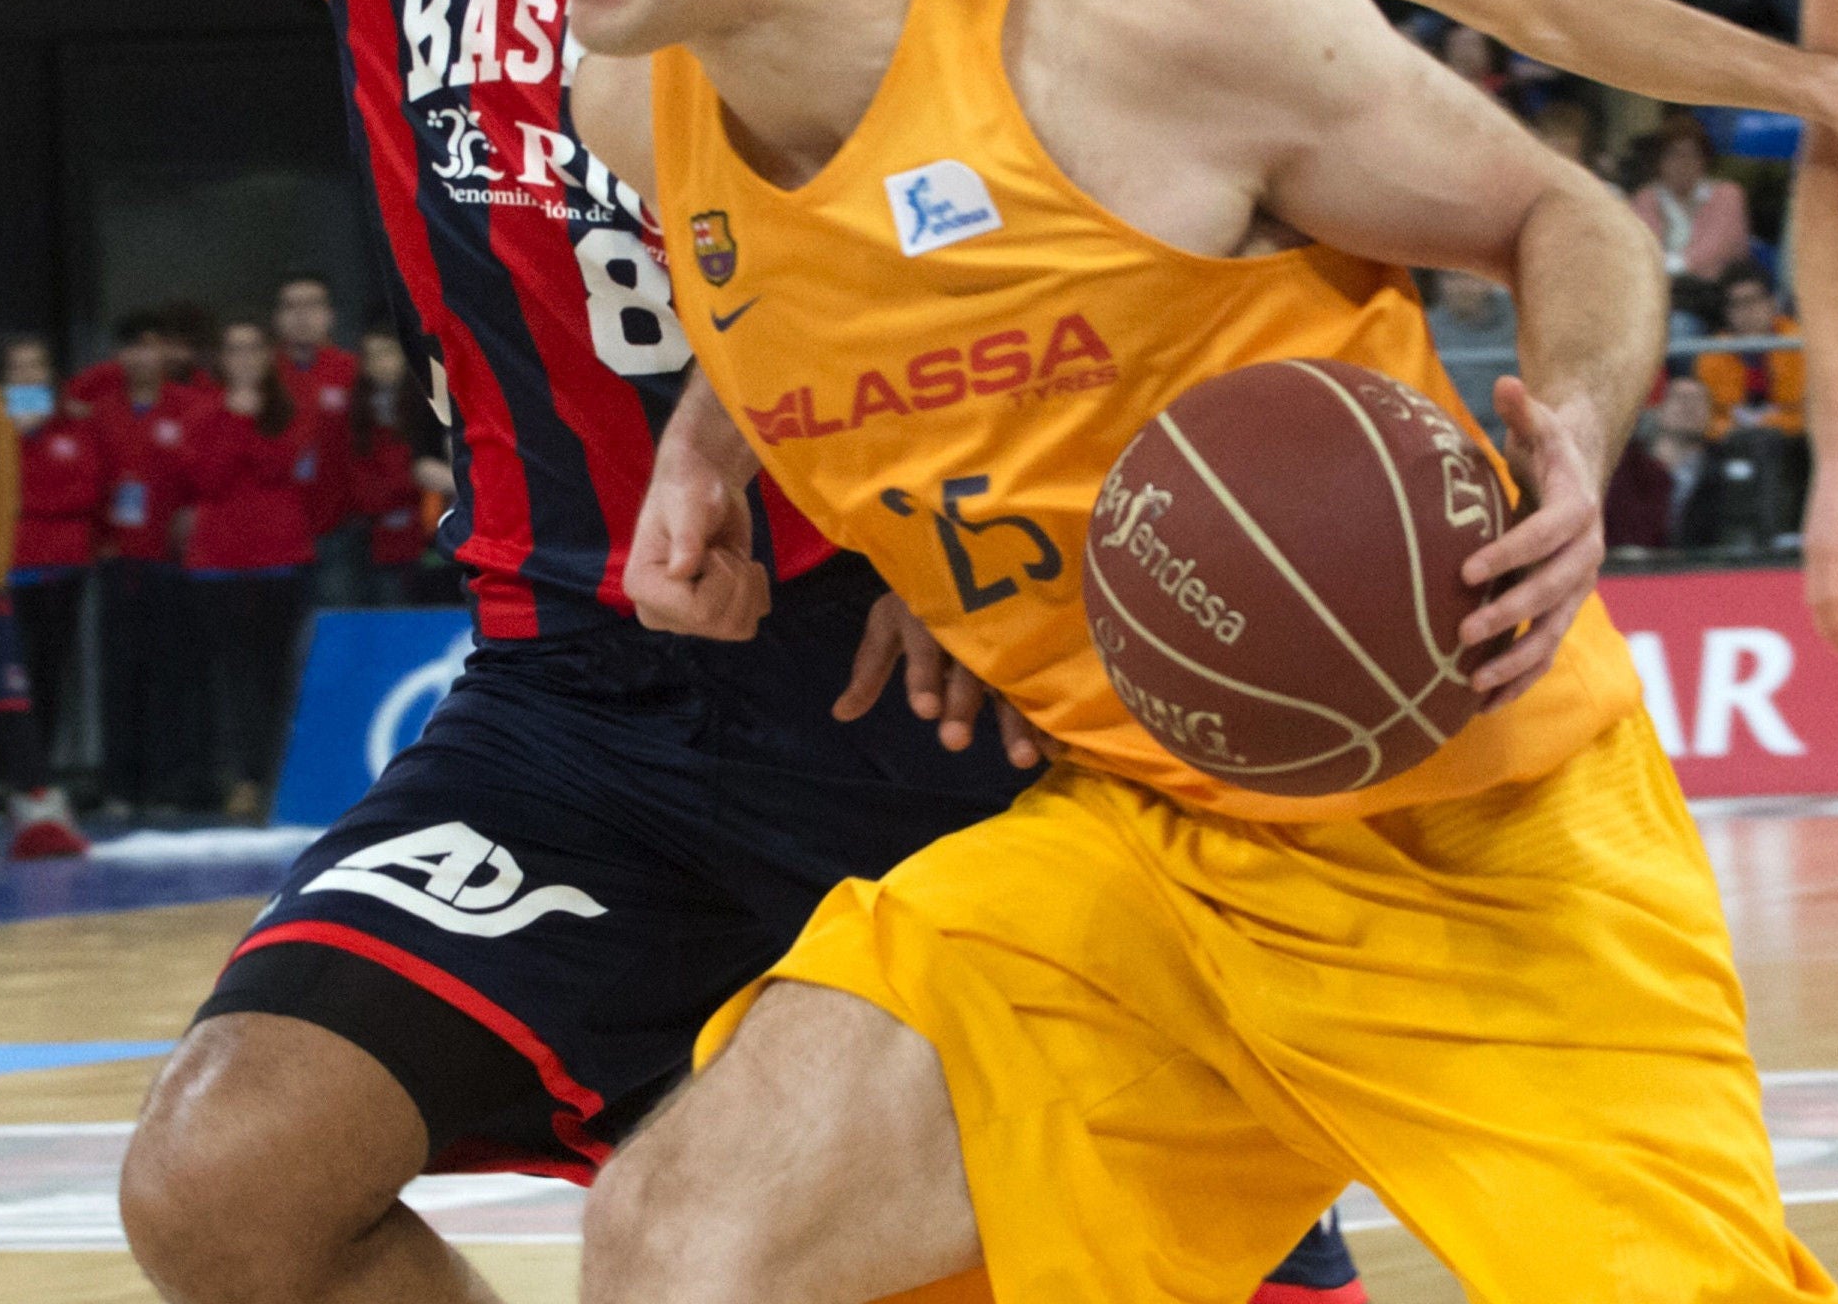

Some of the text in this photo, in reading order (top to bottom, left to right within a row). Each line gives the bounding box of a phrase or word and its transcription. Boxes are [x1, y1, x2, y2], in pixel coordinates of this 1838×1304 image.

[574, 229, 694, 376] 8
[799, 311, 1112, 441] LASSA
[1128, 522, 1247, 644] endesa
